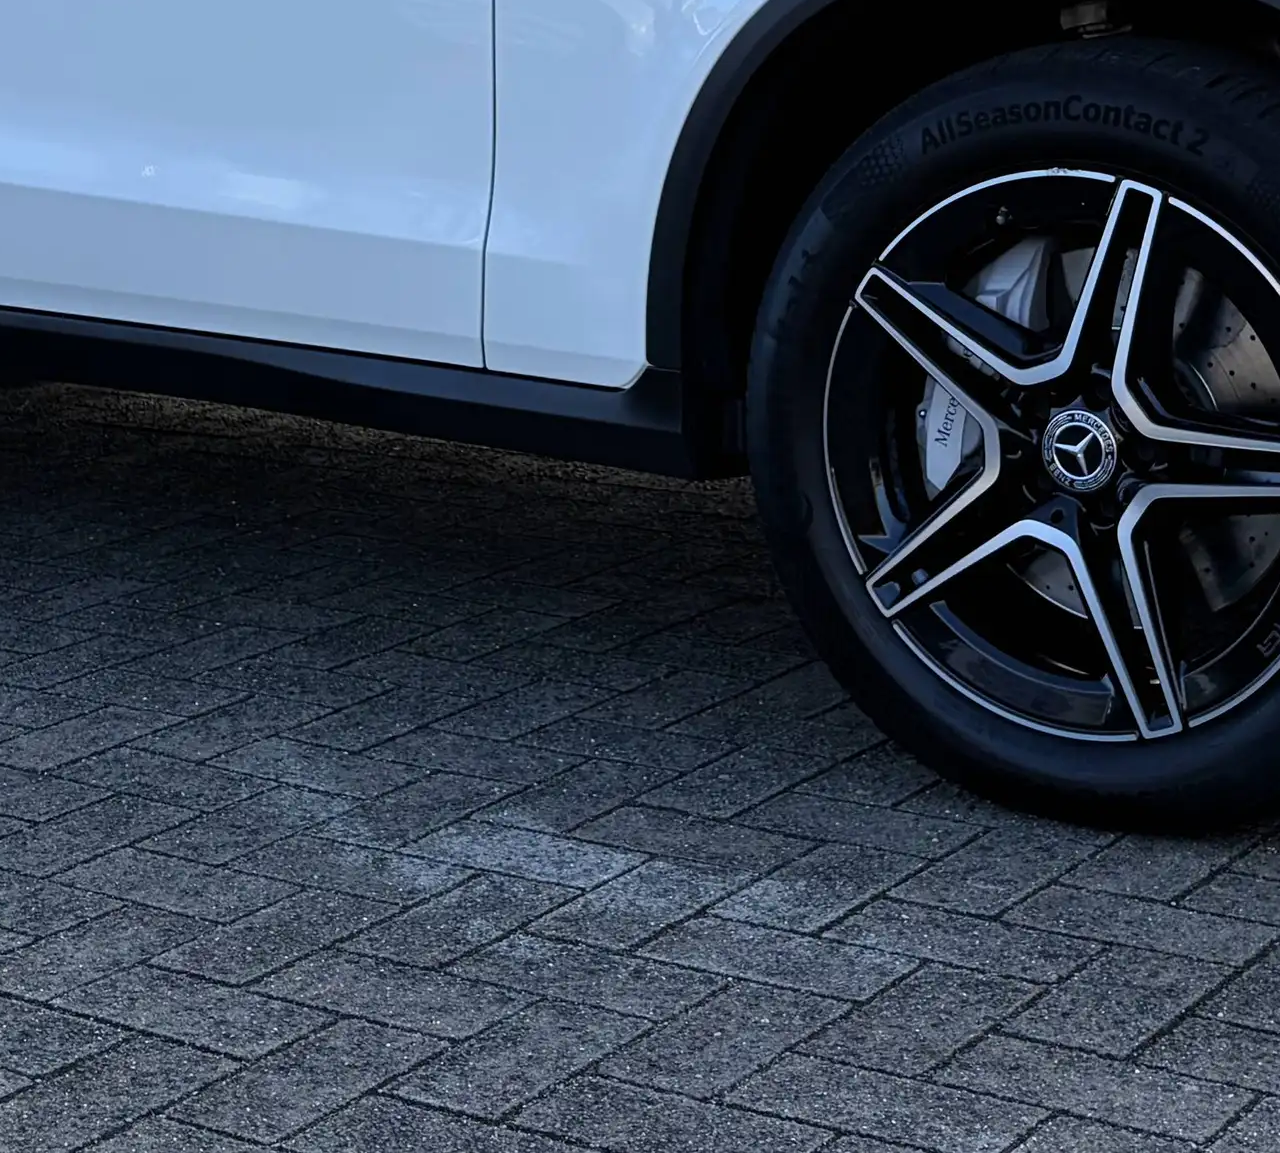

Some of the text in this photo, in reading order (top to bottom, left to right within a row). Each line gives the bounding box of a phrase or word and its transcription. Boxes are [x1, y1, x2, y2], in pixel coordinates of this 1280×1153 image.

[921, 94, 1211, 157] AllSeasonContact 2
[1073, 413, 1114, 453] MERCEDES
[1049, 462, 1073, 486] BENZ
